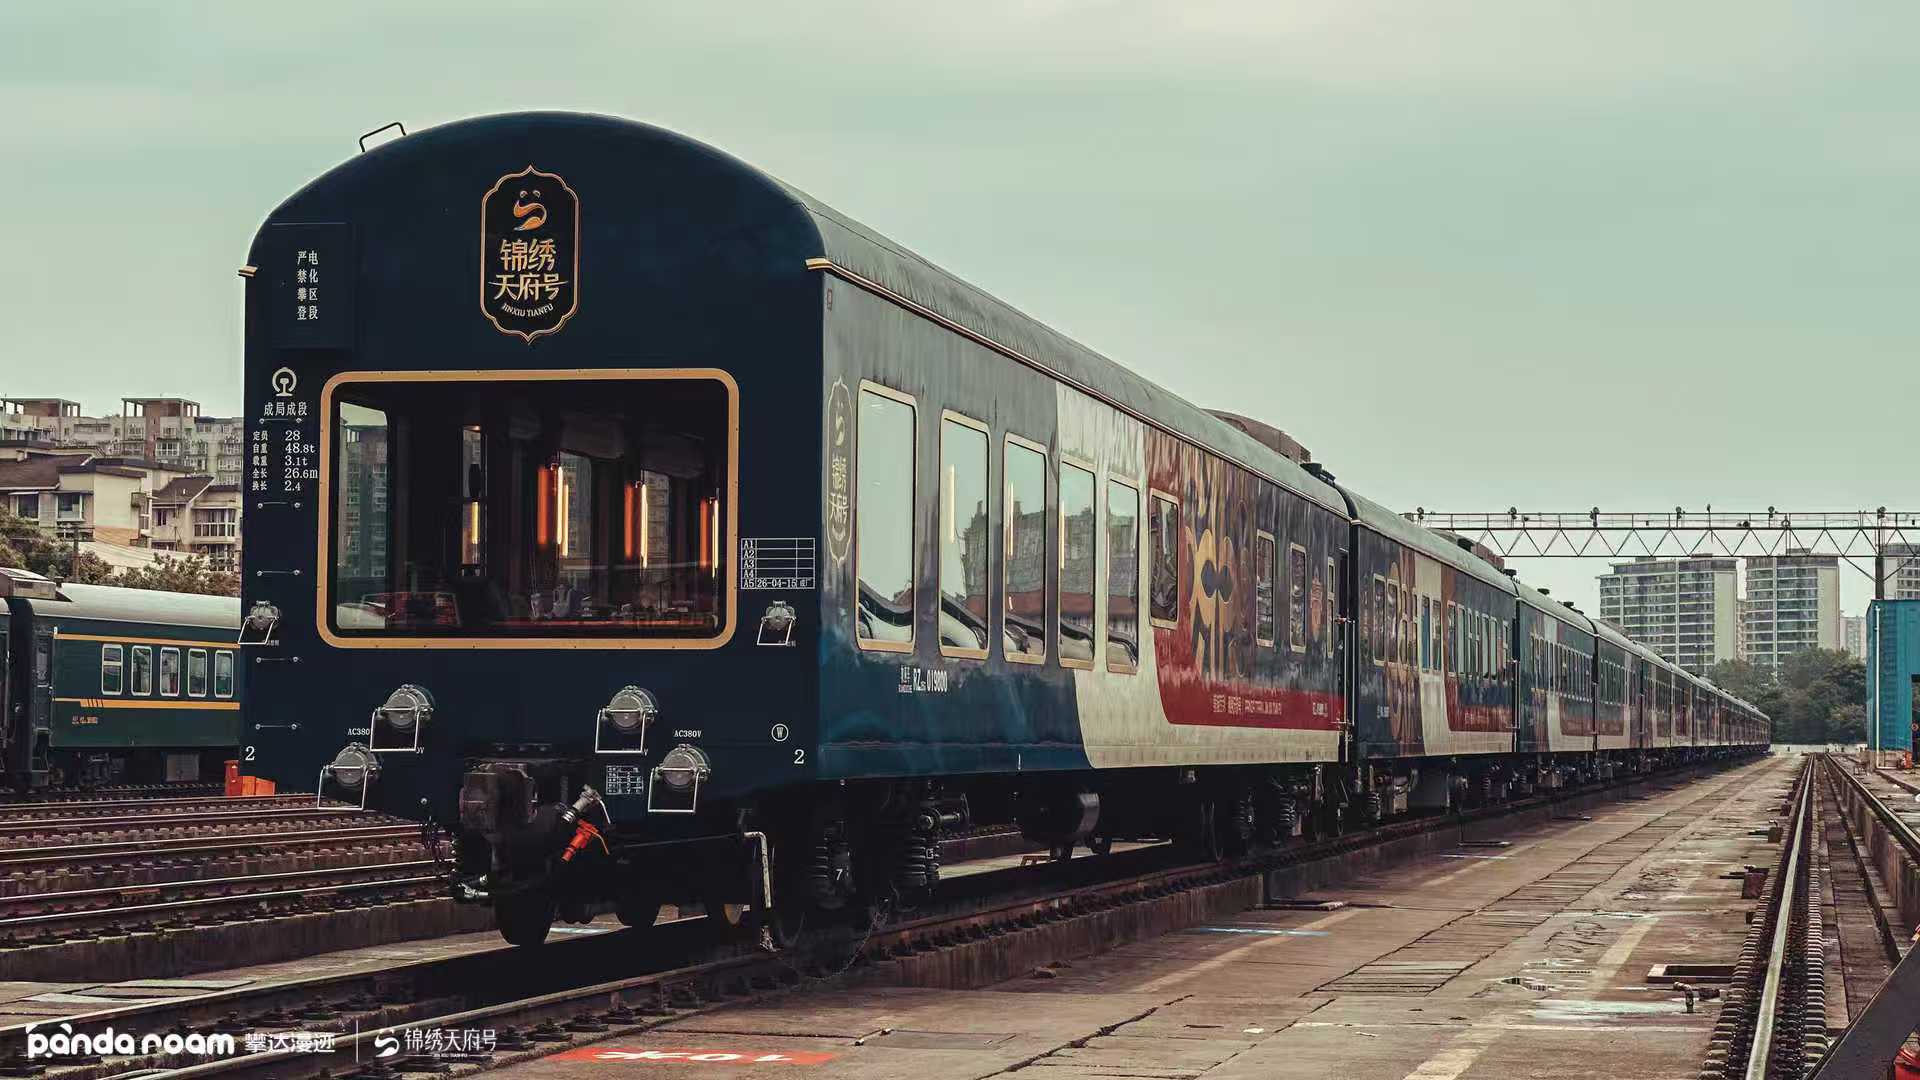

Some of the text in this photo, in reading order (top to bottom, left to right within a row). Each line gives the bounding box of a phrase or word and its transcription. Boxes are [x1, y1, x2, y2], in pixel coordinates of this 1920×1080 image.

[500, 238, 557, 272] 锦绣
[297, 250, 307, 320] 严禁攀登
[309, 250, 319, 320] 电化区段
[490, 273, 564, 301] 天府号
[264, 402, 307, 417] 成局成段
[253, 430, 301, 441] 定员 28
[285, 442, 316, 454] 48.8t
[284, 455, 308, 466] 3.1t
[252, 467, 319, 479] 全长 26.6m
[284, 480, 301, 491] 2.4
[743, 540, 754, 550] A1
[743, 550, 755, 559] A2
[743, 560, 755, 569] A3
[743, 569, 754, 578] A4
[743, 579, 755, 588] A5
[348, 727, 371, 736] AC380
[674, 729, 702, 738] AC380V
[245, 746, 255, 761] 2
[794, 749, 804, 764] 2
[836, 868, 843, 880] 7
